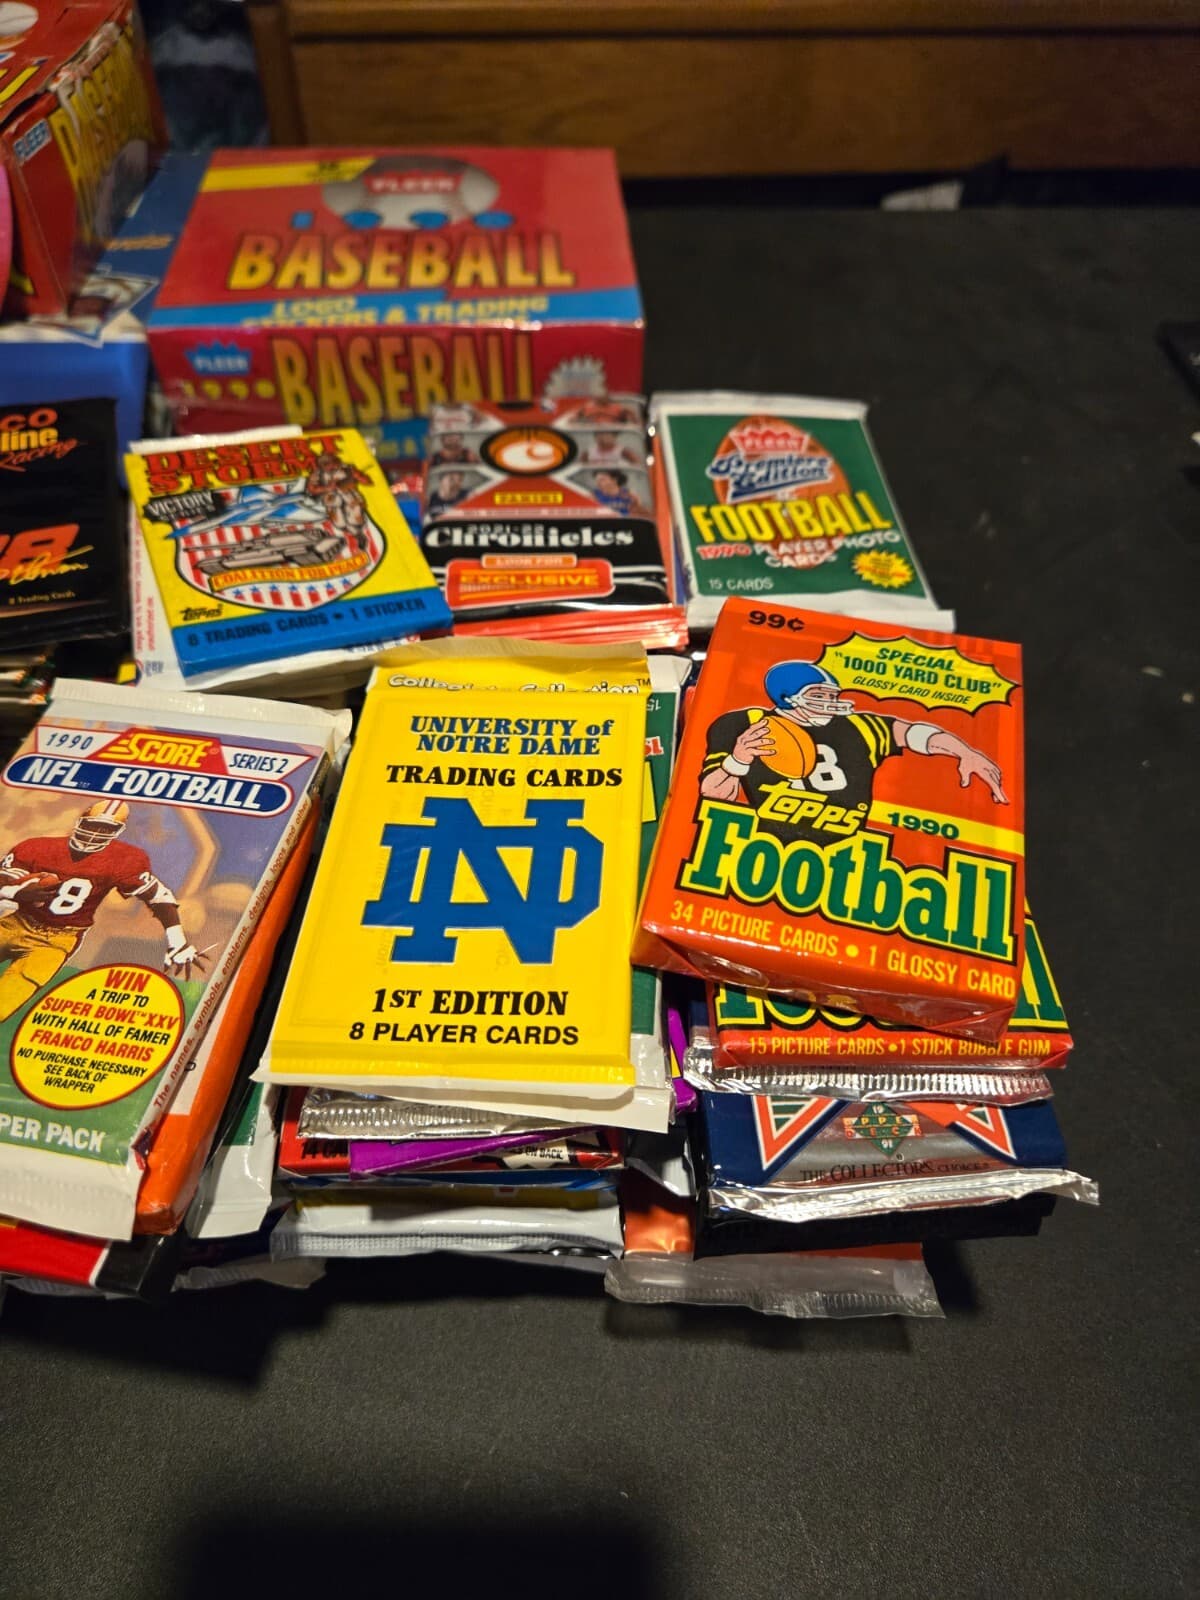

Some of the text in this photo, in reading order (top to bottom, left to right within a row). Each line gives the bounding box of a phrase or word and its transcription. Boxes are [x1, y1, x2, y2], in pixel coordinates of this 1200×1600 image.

[226, 232, 576, 290] BASEBALL
[146, 435, 344, 472] DESERT
[709, 455, 830, 477] Premiere
[149, 456, 318, 494] STORM
[732, 464, 832, 491] Edition
[147, 490, 214, 516] VICTORY
[690, 491, 893, 544] FOOTBALL
[754, 536, 833, 556] PLAYER
[834, 530, 901, 550] PHOTO
[765, 551, 837, 568] CARDS
[459, 573, 599, 587] EXCLUSIVE
[726, 578, 774, 591] CARDS
[204, 621, 273, 645] TRADING
[275, 612, 329, 633] CARDS
[361, 597, 427, 619] STICKER
[748, 610, 805, 632] 99¢
[875, 647, 956, 672] SPECIAL
[893, 665, 939, 686] YARD
[852, 675, 972, 706] GLOSSY CARD INSIDE
[409, 715, 615, 737] UNIVERSITY of
[46, 732, 94, 751] 1990
[100, 733, 213, 768] SCORE
[415, 734, 600, 756] NOTRE DAME
[228, 752, 289, 774] SERIES 2
[21, 757, 263, 810] NFL FOOTBALL
[386, 765, 623, 788] TRADING CARDS
[887, 811, 960, 840] 1990
[684, 802, 1012, 960] Football
[50, 877, 94, 915] 8
[670, 900, 694, 923] 34
[701, 907, 773, 944] PICTURE
[780, 923, 839, 959] CARDS
[887, 948, 960, 986] GLOSSY
[966, 967, 1016, 1000] CARD
[104, 969, 151, 994] WIN
[86, 988, 149, 1008] A TRIP TO
[372, 988, 569, 1016] 1ST EDITION
[41, 997, 93, 1018] SUPER
[143, 1013, 180, 1031] XXV
[31, 1012, 171, 1046] WITH HALL OF FAMER
[349, 1022, 580, 1046] 8 PLAYER CARDS
[29, 1029, 155, 1063] FRANCO HARRIS
[750, 1037, 767, 1055] 15
[771, 1036, 831, 1055] PICTURE
[837, 1036, 885, 1056] CARDS
[911, 1038, 953, 1056] STICK
[1018, 1038, 1050, 1057] GUM
[16, 1047, 149, 1078] NO PURCHASE NECESSARY
[43, 1063, 108, 1083] SEE BACK OF
[43, 1076, 96, 1094] WRAPPER
[152, 1083, 171, 1108] The
[0, 1113, 107, 1154] PER PACK
[801, 1168, 826, 1182] THE
